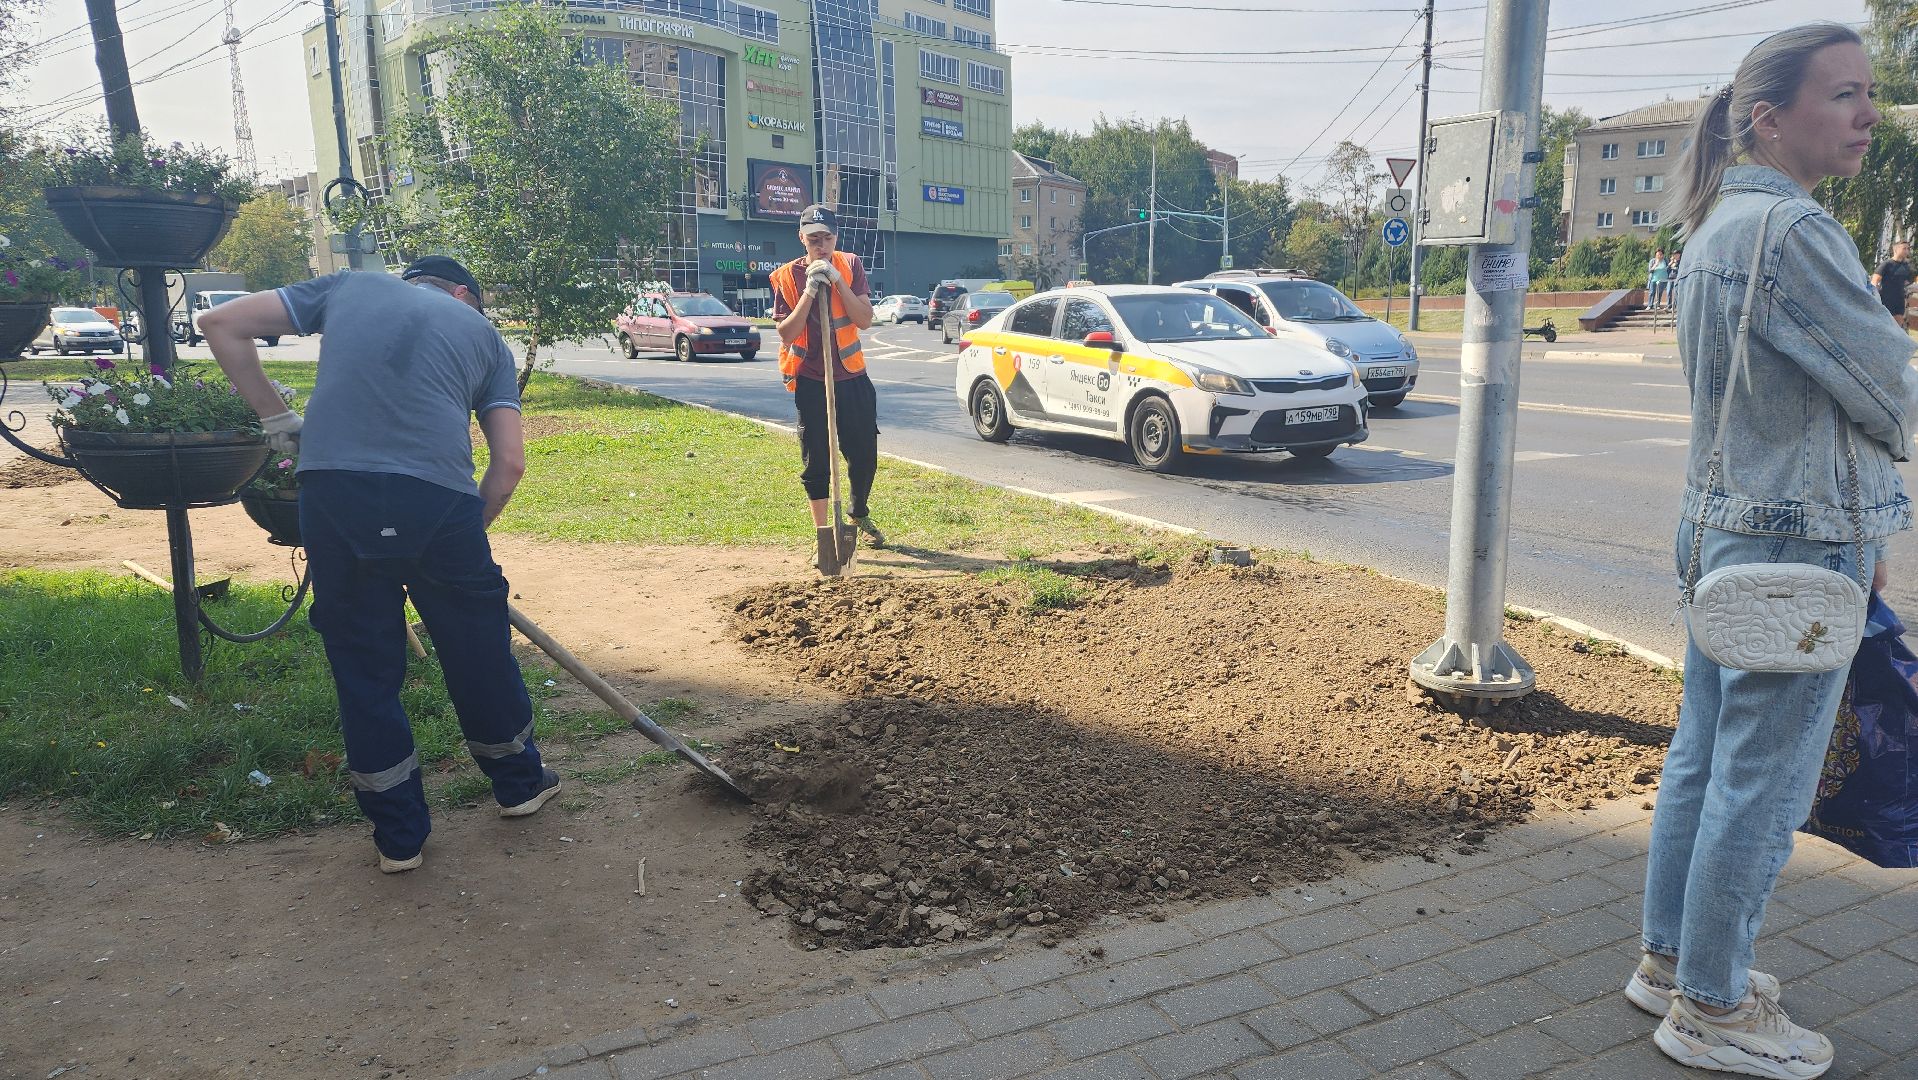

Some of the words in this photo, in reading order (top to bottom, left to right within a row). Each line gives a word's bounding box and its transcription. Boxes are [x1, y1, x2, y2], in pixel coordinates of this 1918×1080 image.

[564, 11, 606, 25] ТОРАН
[618, 15, 695, 39] ТИПОГРАФИЯ
[758, 115, 806, 133] КОРАБЛИК
[812, 209, 825, 221] LA
[757, 261, 785, 271] лент
[1070, 369, 1096, 386] Яндекс
[1086, 390, 1106, 406] Такси
[1821, 823, 1865, 838] ECTION
